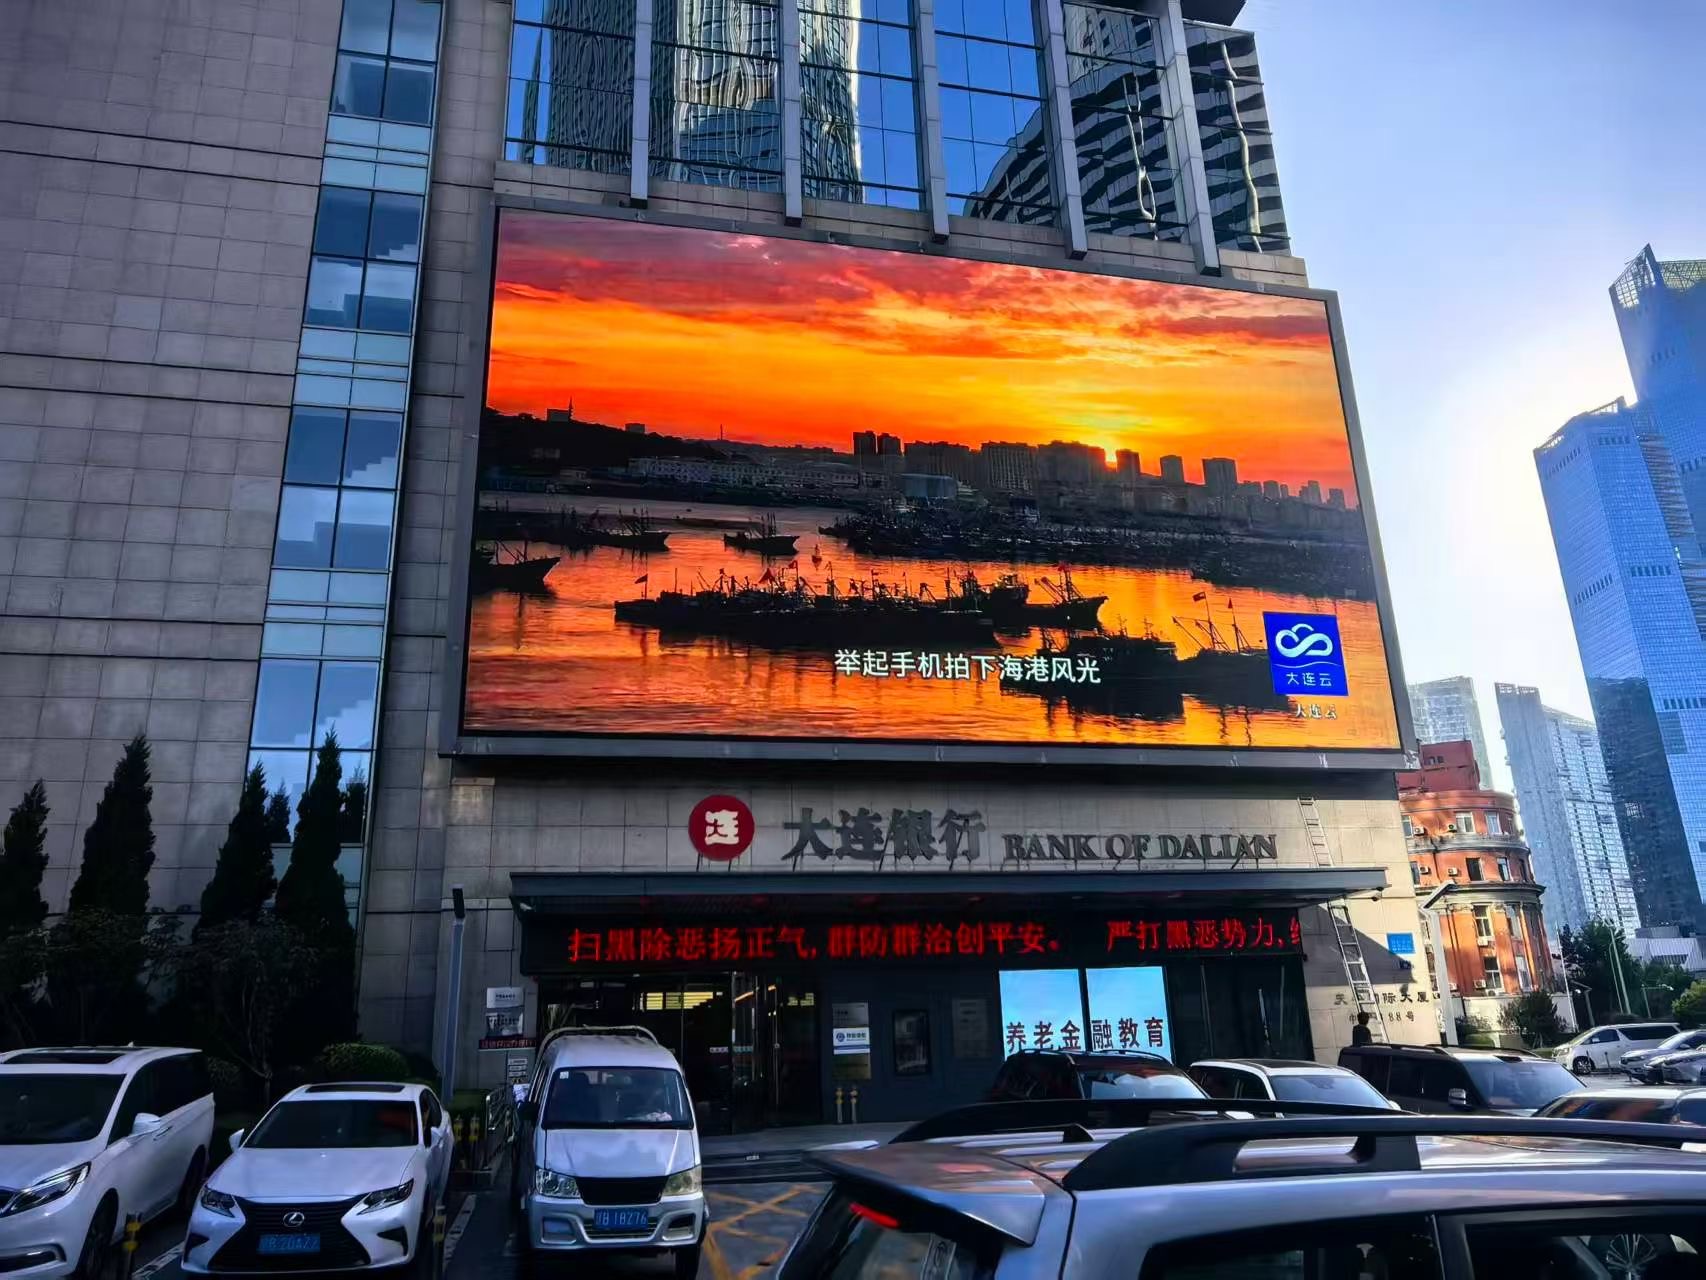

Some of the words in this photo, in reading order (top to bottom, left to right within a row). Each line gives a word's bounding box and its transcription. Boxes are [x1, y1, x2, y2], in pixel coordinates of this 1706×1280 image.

[834, 648, 1102, 684] 举起手机拍下海港风光
[1286, 672, 1332, 687] 大连云
[1295, 703, 1338, 720] 大连云
[781, 807, 986, 861] 大连银行
[1002, 834, 1099, 860] BANK
[1105, 834, 1150, 860] OF
[1159, 834, 1278, 859] DALIAN
[1006, 1017, 1165, 1053] 养老金融教育
